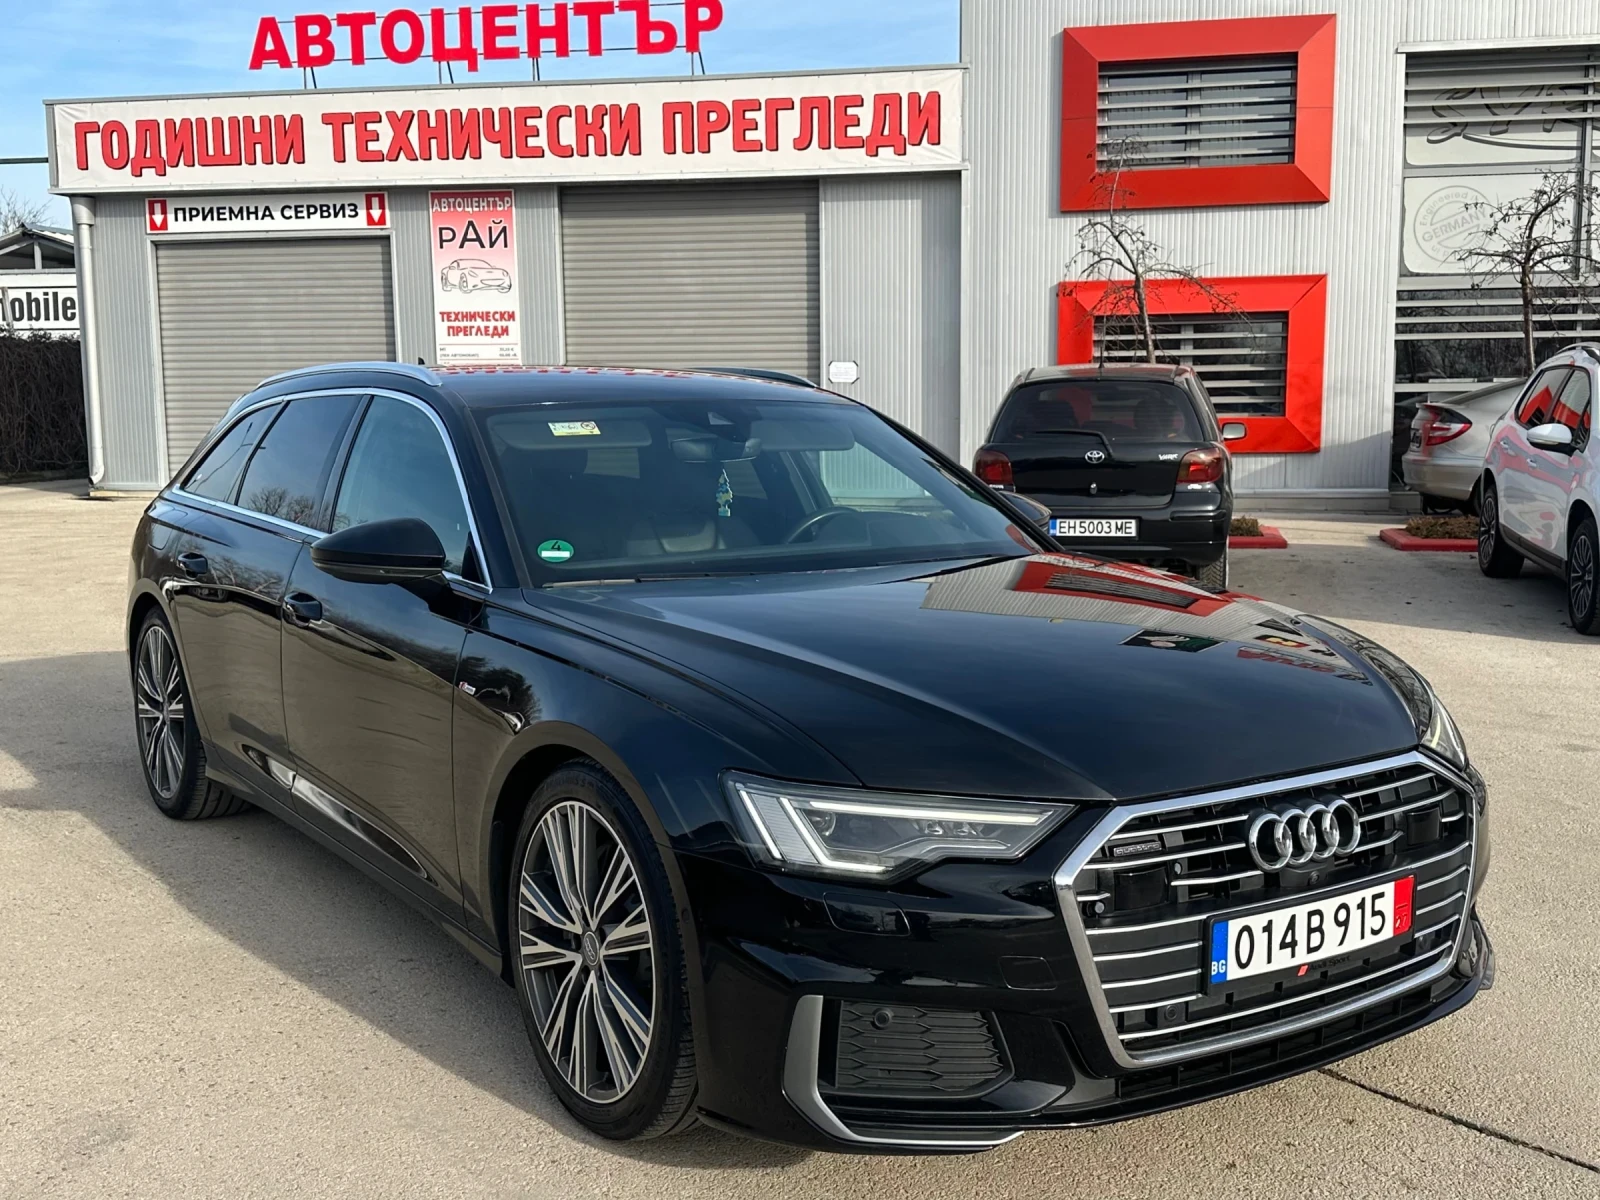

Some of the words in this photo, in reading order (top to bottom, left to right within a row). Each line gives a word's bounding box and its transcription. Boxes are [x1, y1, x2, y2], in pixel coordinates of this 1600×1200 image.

[249, 0, 723, 72] АВТОЦЕНТЪР
[74, 114, 305, 177] ГОДИШНИ
[322, 103, 641, 163] ТЕХНИЧЕСКИ
[662, 91, 940, 157] ПРЕГЛЕДИ
[173, 205, 275, 222] ПРИЕМНА
[280, 203, 359, 220] СЕРВИЗ
[433, 197, 512, 214] АВТОЦЕНТЪР
[1422, 206, 1487, 242] GERMANY
[438, 219, 508, 249] РАЙ
[439, 310, 516, 323] ТЕХНИЧЕСКИ
[446, 325, 510, 339] ПРЕГЛЕДИ
[550, 540, 562, 551] 4
[1211, 959, 1226, 975] BG
